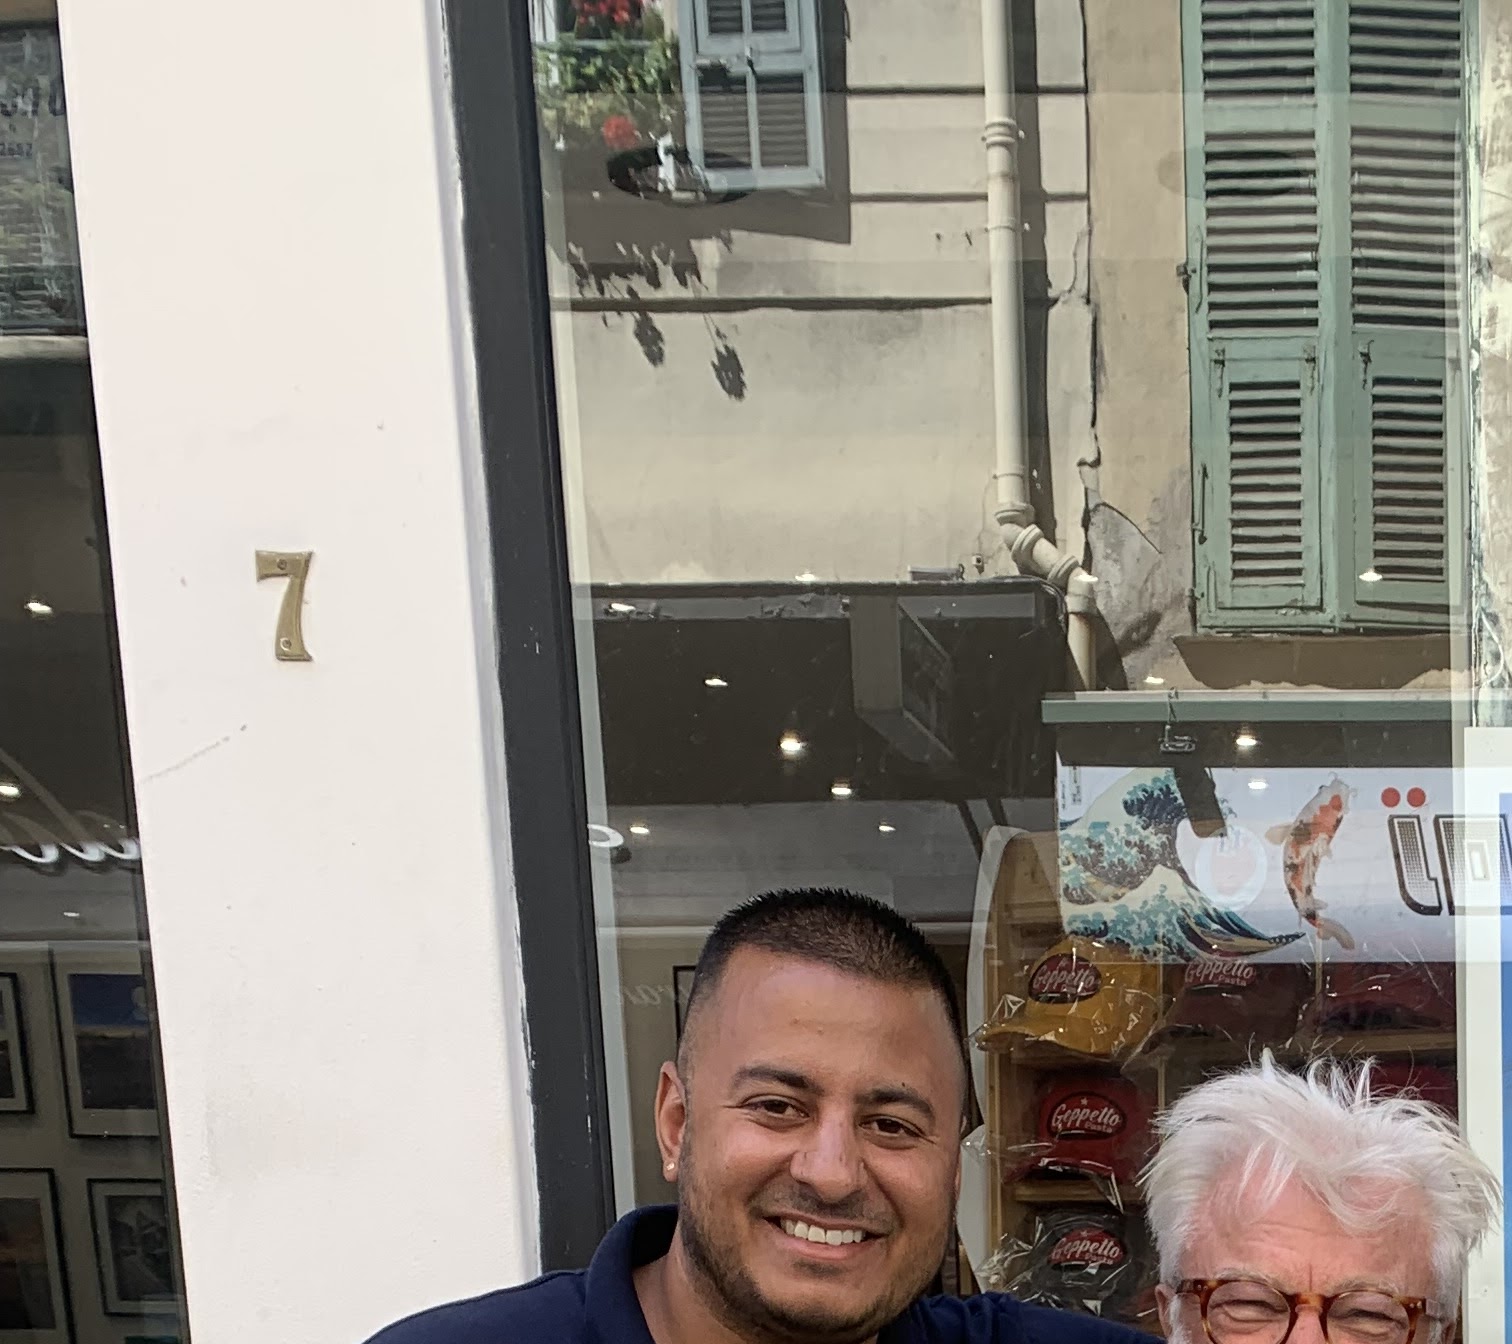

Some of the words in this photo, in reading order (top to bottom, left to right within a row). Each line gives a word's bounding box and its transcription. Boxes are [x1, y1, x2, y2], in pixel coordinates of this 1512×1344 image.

[255, 550, 313, 661] 7
[1051, 1103, 1121, 1128] Geppetto
[1051, 1237, 1121, 1260] Geppetto
